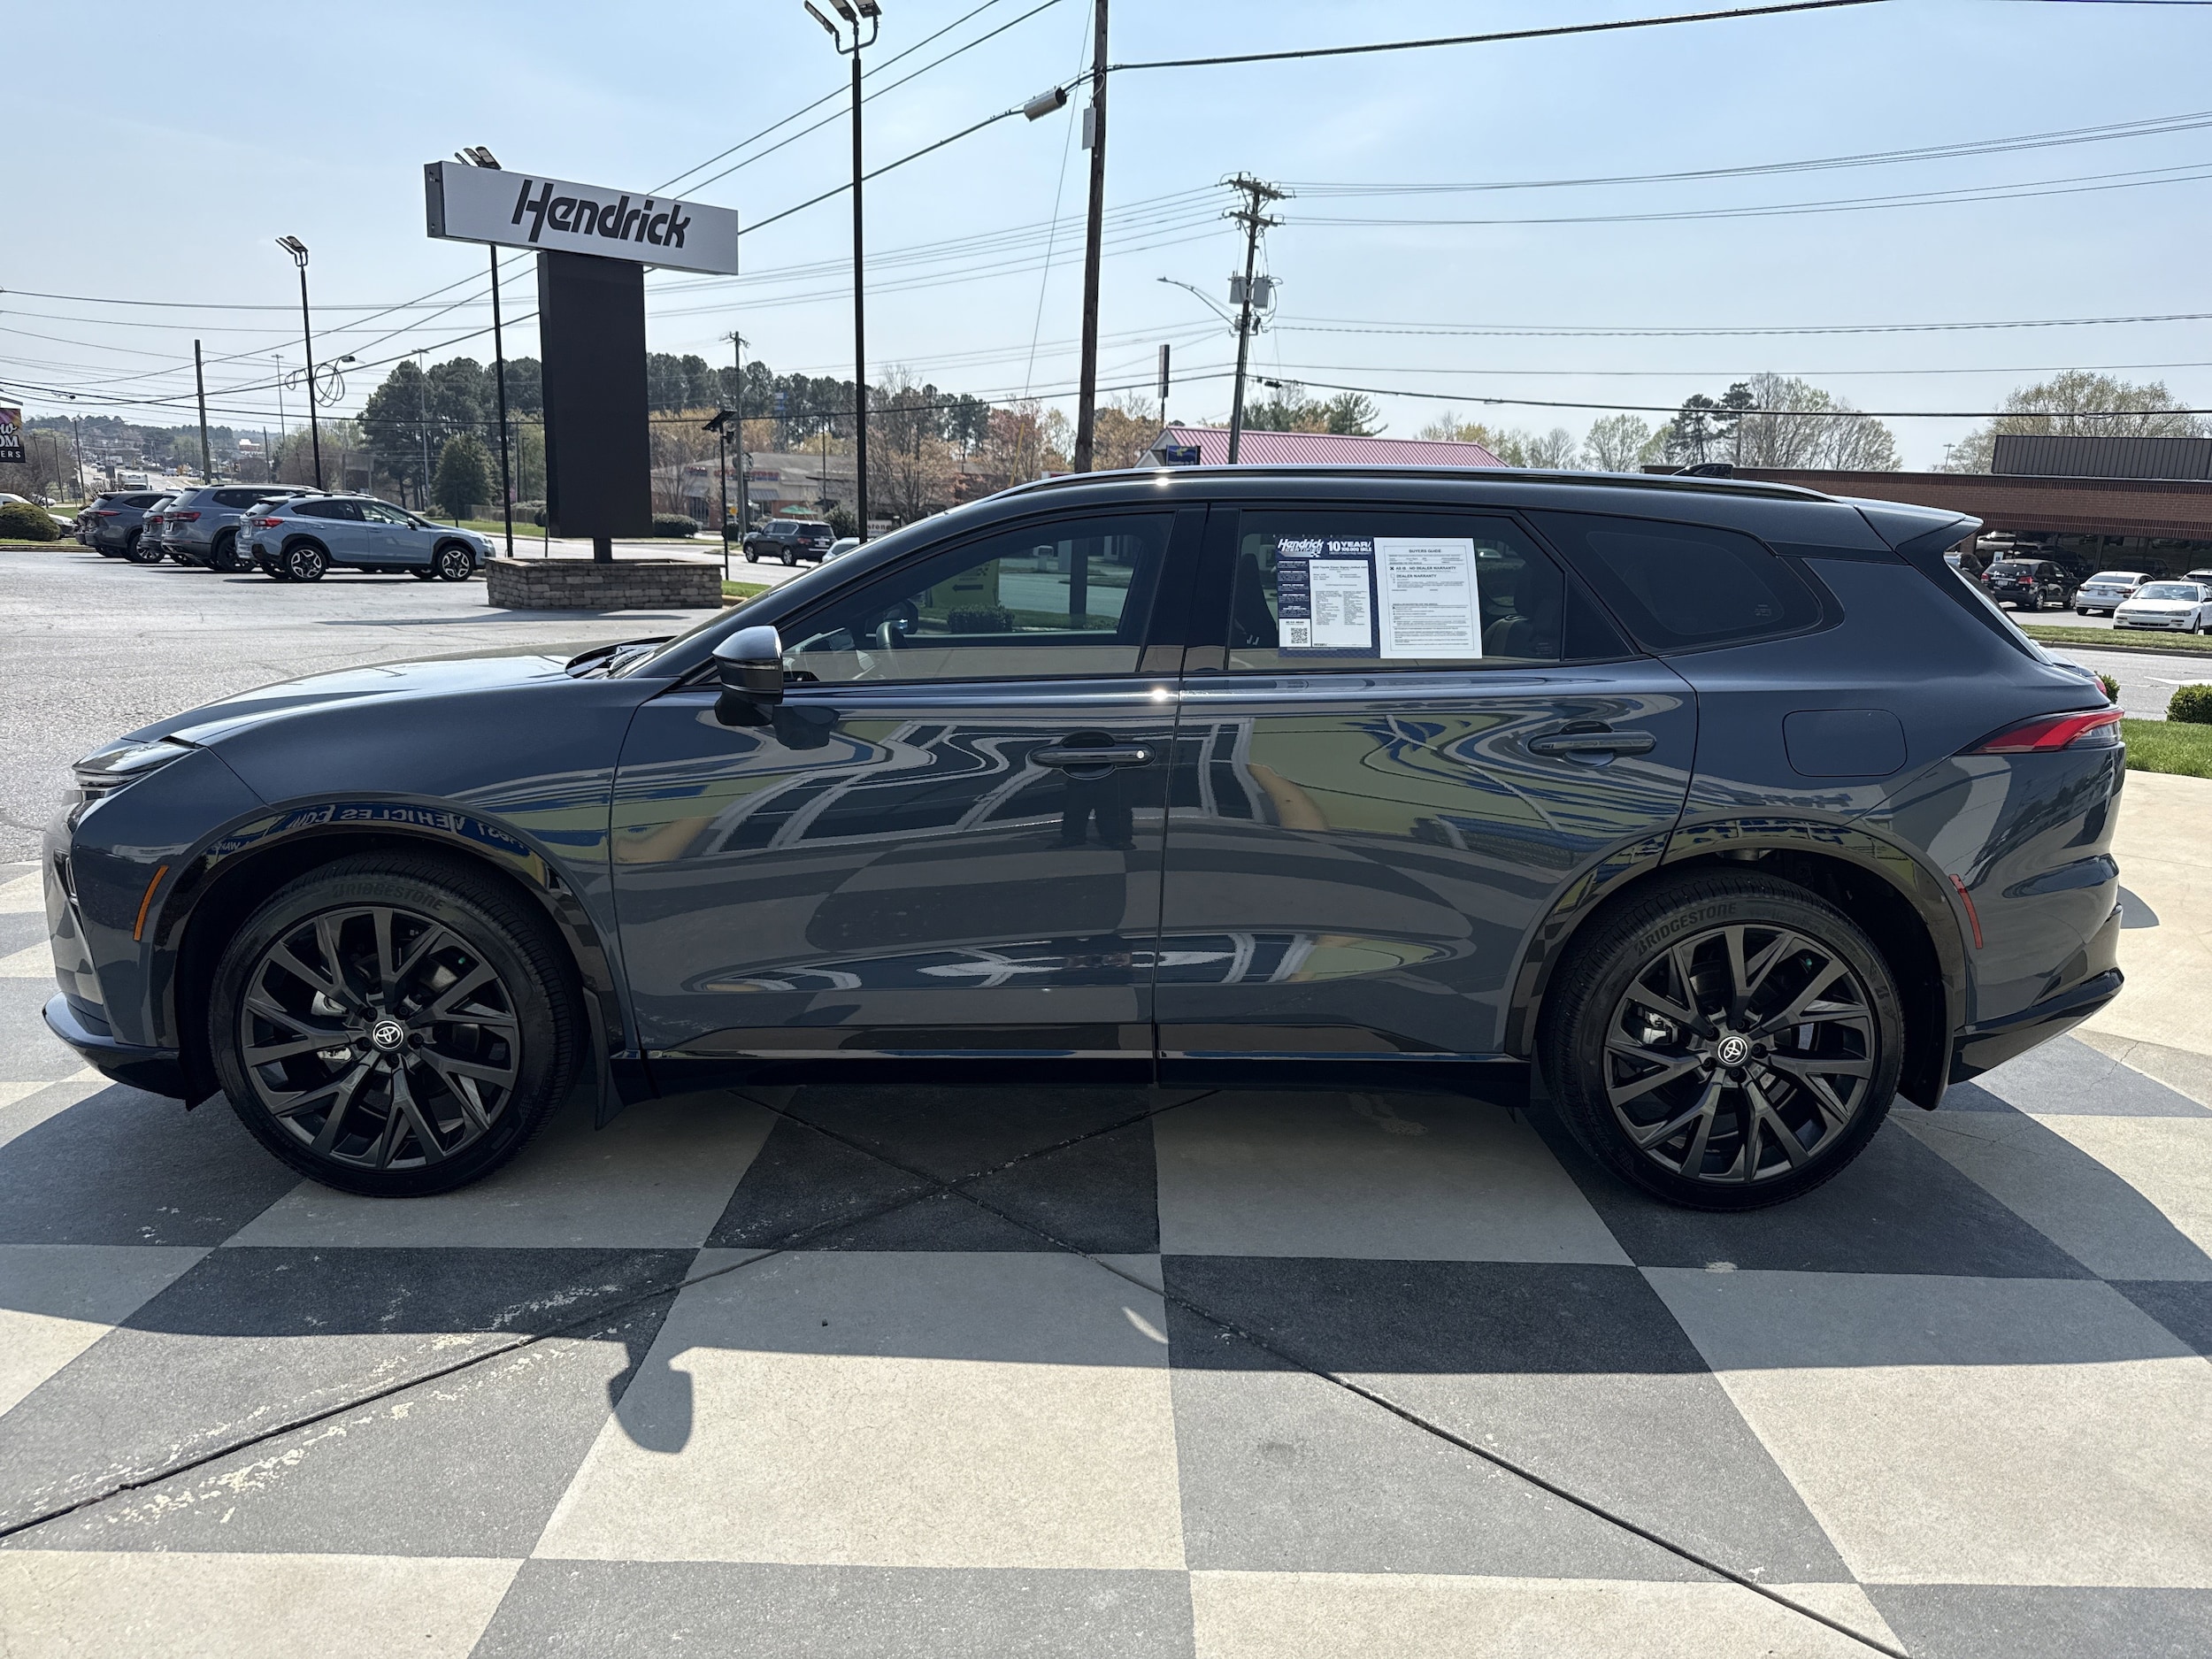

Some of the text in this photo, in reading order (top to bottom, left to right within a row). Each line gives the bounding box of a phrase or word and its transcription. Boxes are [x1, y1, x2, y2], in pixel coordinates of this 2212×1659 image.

[511, 179, 691, 249] Hendrick
[1278, 538, 1325, 552] Hendrick
[1327, 541, 1341, 552] 10
[332, 882, 447, 911] BRIDGESTONE
[1637, 902, 1737, 957] BRIDGESTONE
